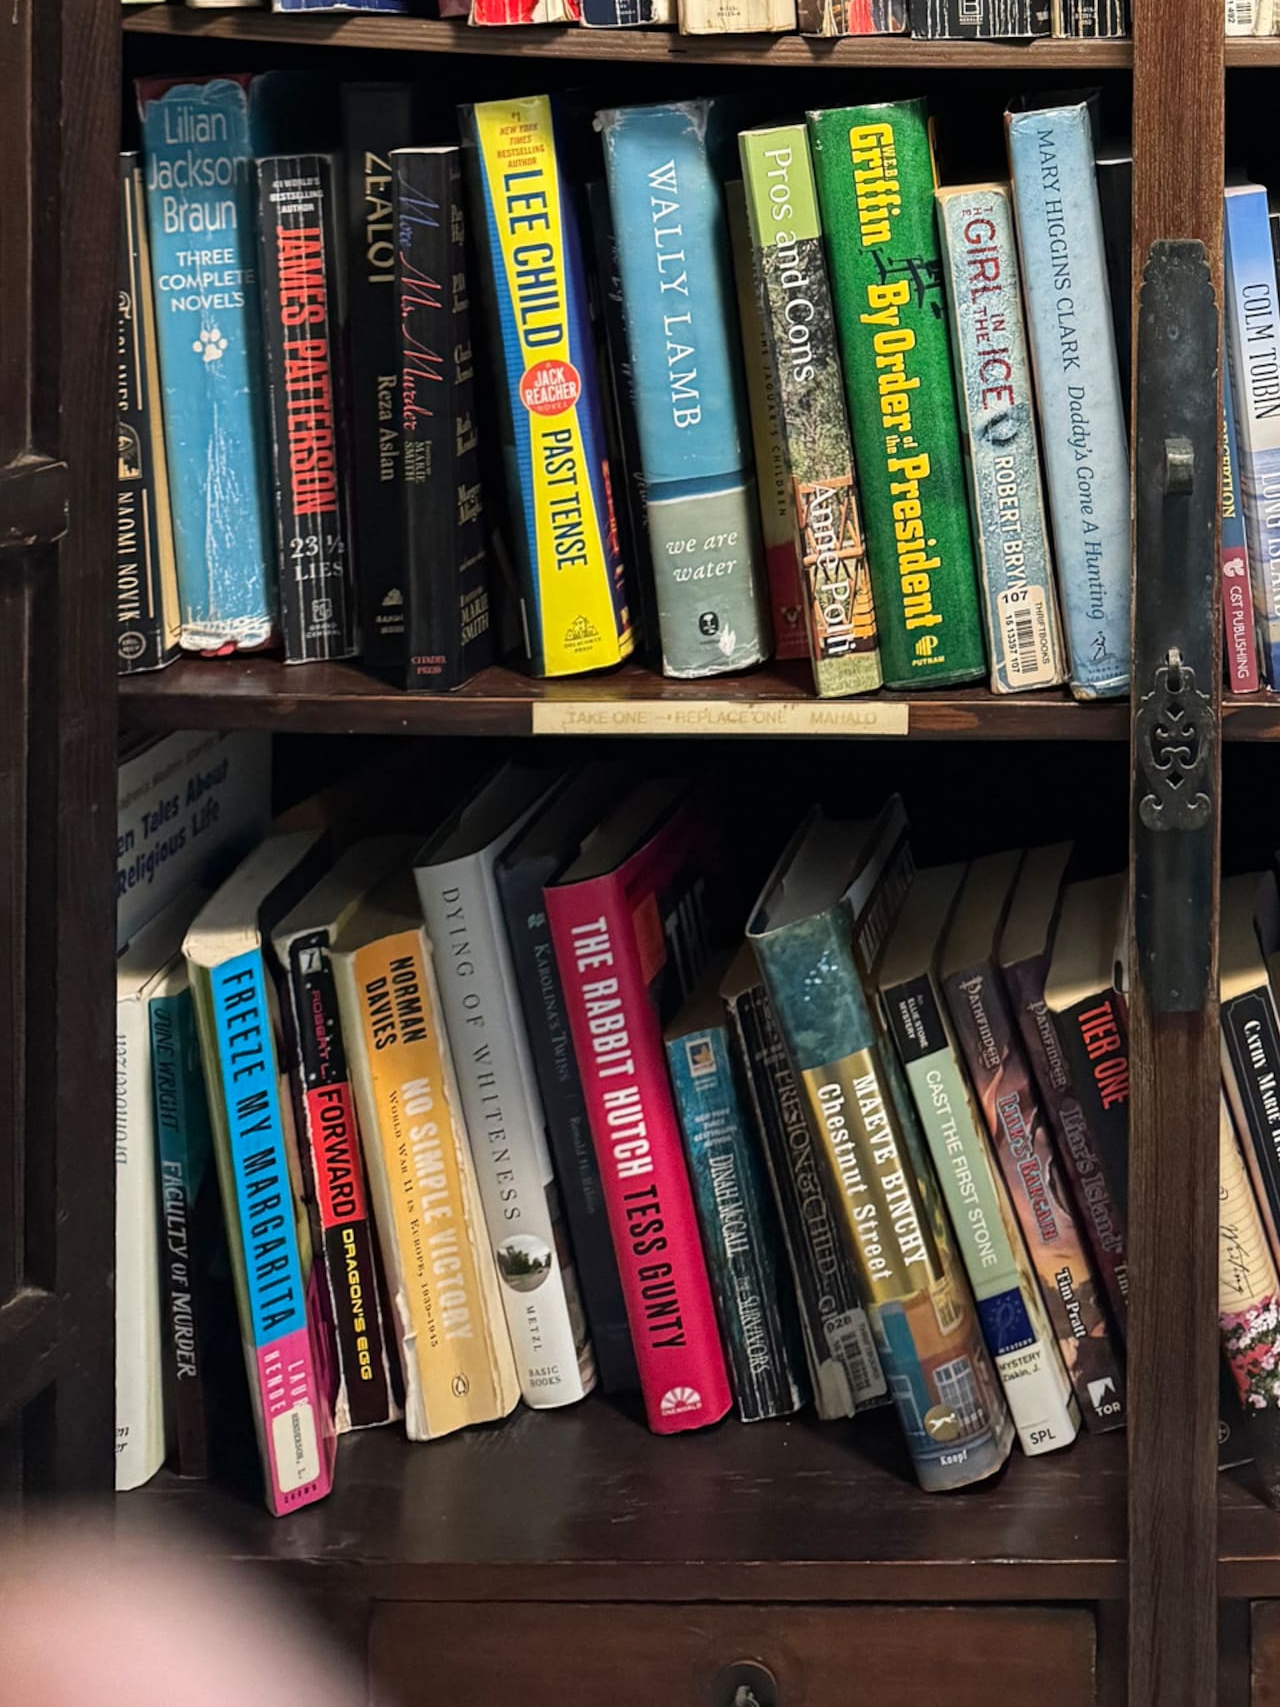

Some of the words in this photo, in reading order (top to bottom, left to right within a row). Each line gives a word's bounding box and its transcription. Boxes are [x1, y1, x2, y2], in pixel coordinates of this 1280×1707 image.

[164, 105, 228, 146] Lilian
[1036, 129, 1061, 192] MARY
[148, 152, 249, 191] Jackson
[503, 169, 550, 236] LEE
[762, 146, 795, 220] Pros
[848, 122, 902, 247] Griffin
[162, 196, 238, 235] Braun
[646, 158, 690, 297] WALLY
[1044, 197, 1072, 291] HIGGINS
[176, 249, 235, 266] THREE
[276, 225, 322, 326] JAMES
[774, 229, 809, 289] and
[170, 292, 246, 312] NOVELS
[510, 243, 564, 350] CHILD
[859, 279, 911, 327] By
[1055, 296, 1081, 373] CLARK
[663, 314, 702, 430] LAMB
[784, 297, 815, 384] Cons
[524, 383, 578, 406] REACHER
[533, 372, 565, 390] JACK
[872, 327, 921, 432] Order
[284, 340, 338, 516] PATTERSON
[541, 428, 577, 489] PAST
[885, 434, 900, 455] the
[902, 434, 918, 449] of
[1066, 385, 1093, 460] Daddy's
[994, 455, 1022, 533] ROBERT
[1076, 466, 1094, 516] Gone
[1083, 520, 1099, 534] A
[552, 490, 588, 571] TENSE
[887, 453, 943, 631] President
[1002, 591, 1028, 603] 107
[1085, 541, 1108, 620] Hunting
[1035, 601, 1050, 665] THRIFTBOOKS
[567, 711, 609, 725] TAKE
[612, 710, 647, 725] ONE
[675, 710, 748, 724] REPLACE
[751, 710, 786, 724] ONE
[810, 711, 877, 726] MAHALO
[440, 886, 473, 978] DYING
[569, 915, 611, 974] THE
[221, 968, 264, 1084] FREEZE
[364, 975, 398, 1052] DAVIES
[388, 954, 428, 1046] NORMAN
[463, 991, 486, 1029] OF
[580, 976, 636, 1079] RABBIT
[236, 1088, 269, 1139] MY
[401, 1076, 422, 1115] NO
[602, 1086, 656, 1180] HUTCH
[316, 1088, 358, 1218] FORWARD
[408, 1119, 448, 1221] SIMPLE
[472, 1045, 521, 1223] WHITENESS
[851, 1068, 898, 1170] MAEVE
[878, 1174, 930, 1269] BINCHY
[623, 1184, 667, 1251] TESS
[816, 1081, 868, 1198] Chestnut
[852, 1203, 893, 1283] Street
[240, 1145, 297, 1335] MARGARITA
[426, 1222, 474, 1344] VICTORY
[636, 1258, 688, 1352] GUNTY
[525, 1303, 543, 1355] METZL
[1029, 1428, 1057, 1446] SPL
